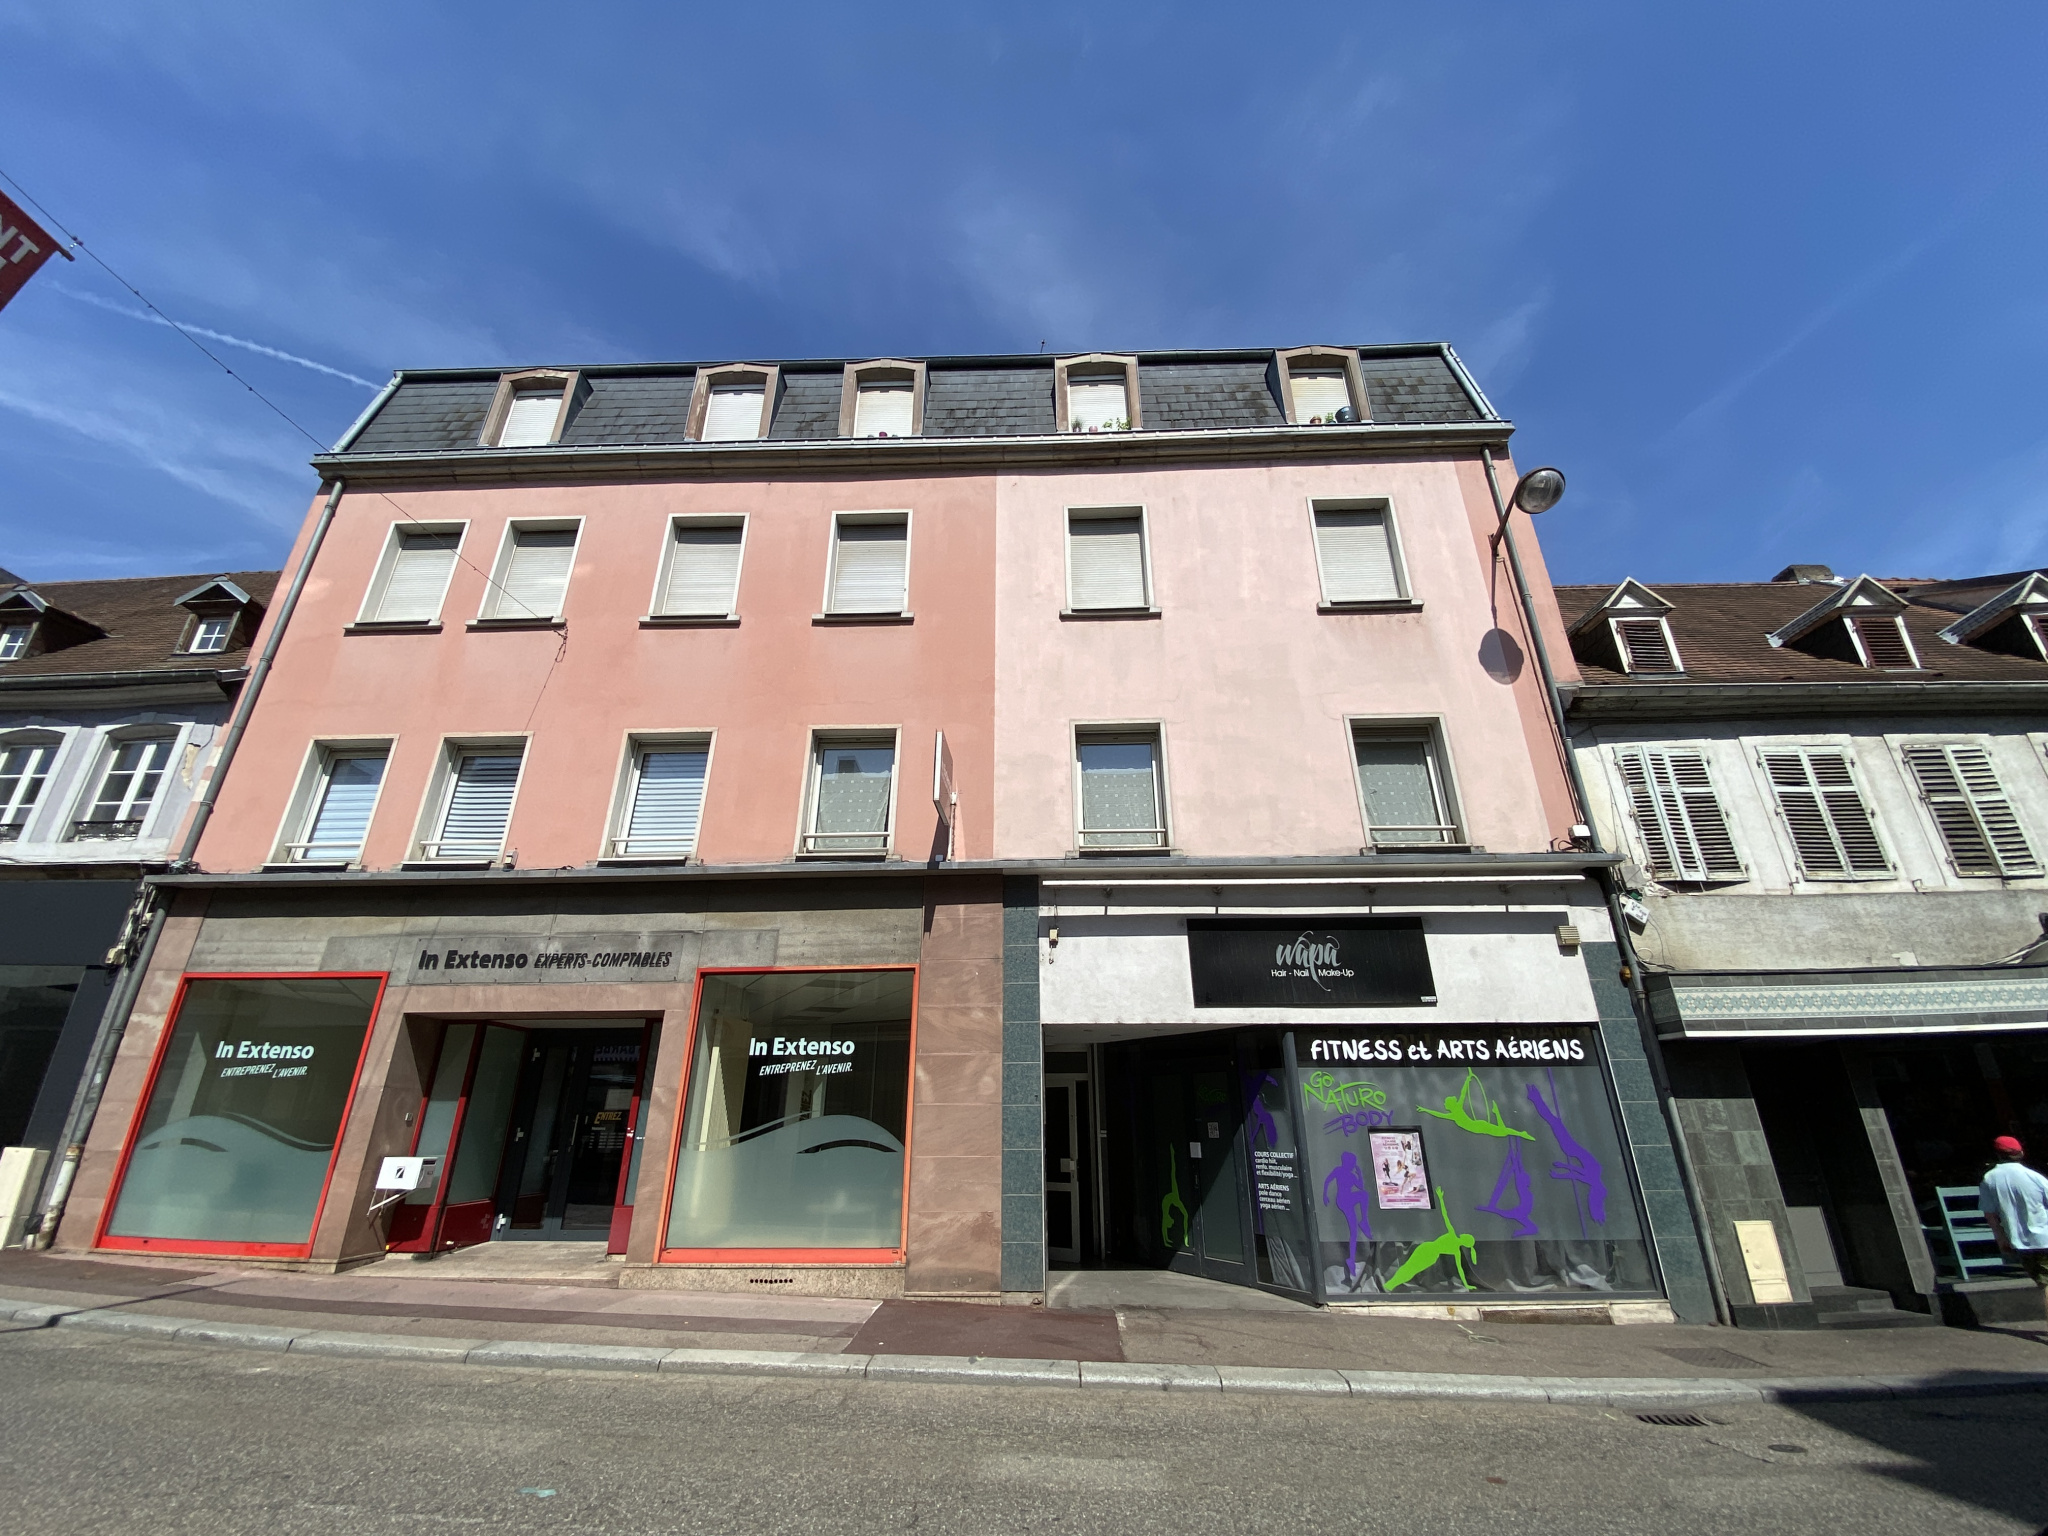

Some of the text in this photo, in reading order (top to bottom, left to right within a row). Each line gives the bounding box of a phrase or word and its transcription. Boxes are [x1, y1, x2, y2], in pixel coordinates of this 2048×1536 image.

[418, 950, 439, 969] In
[444, 950, 528, 969] Extenso
[1271, 969, 1287, 977] Hair
[1294, 969, 1310, 977] Nail
[1318, 969, 1354, 978] Make-Up
[215, 1041, 314, 1059] In Extenso
[749, 1037, 855, 1056] In Extenso
[1310, 1039, 1401, 1060] FITNESS
[1407, 1043, 1432, 1060] et
[1436, 1039, 1490, 1060] ARTS
[1495, 1036, 1584, 1060] AÉRIENS
[220, 1063, 276, 1077] ENTREPRENEZ
[759, 1060, 817, 1076] ENTREPRENEZ
[1338, 1110, 1393, 1137] BODY
